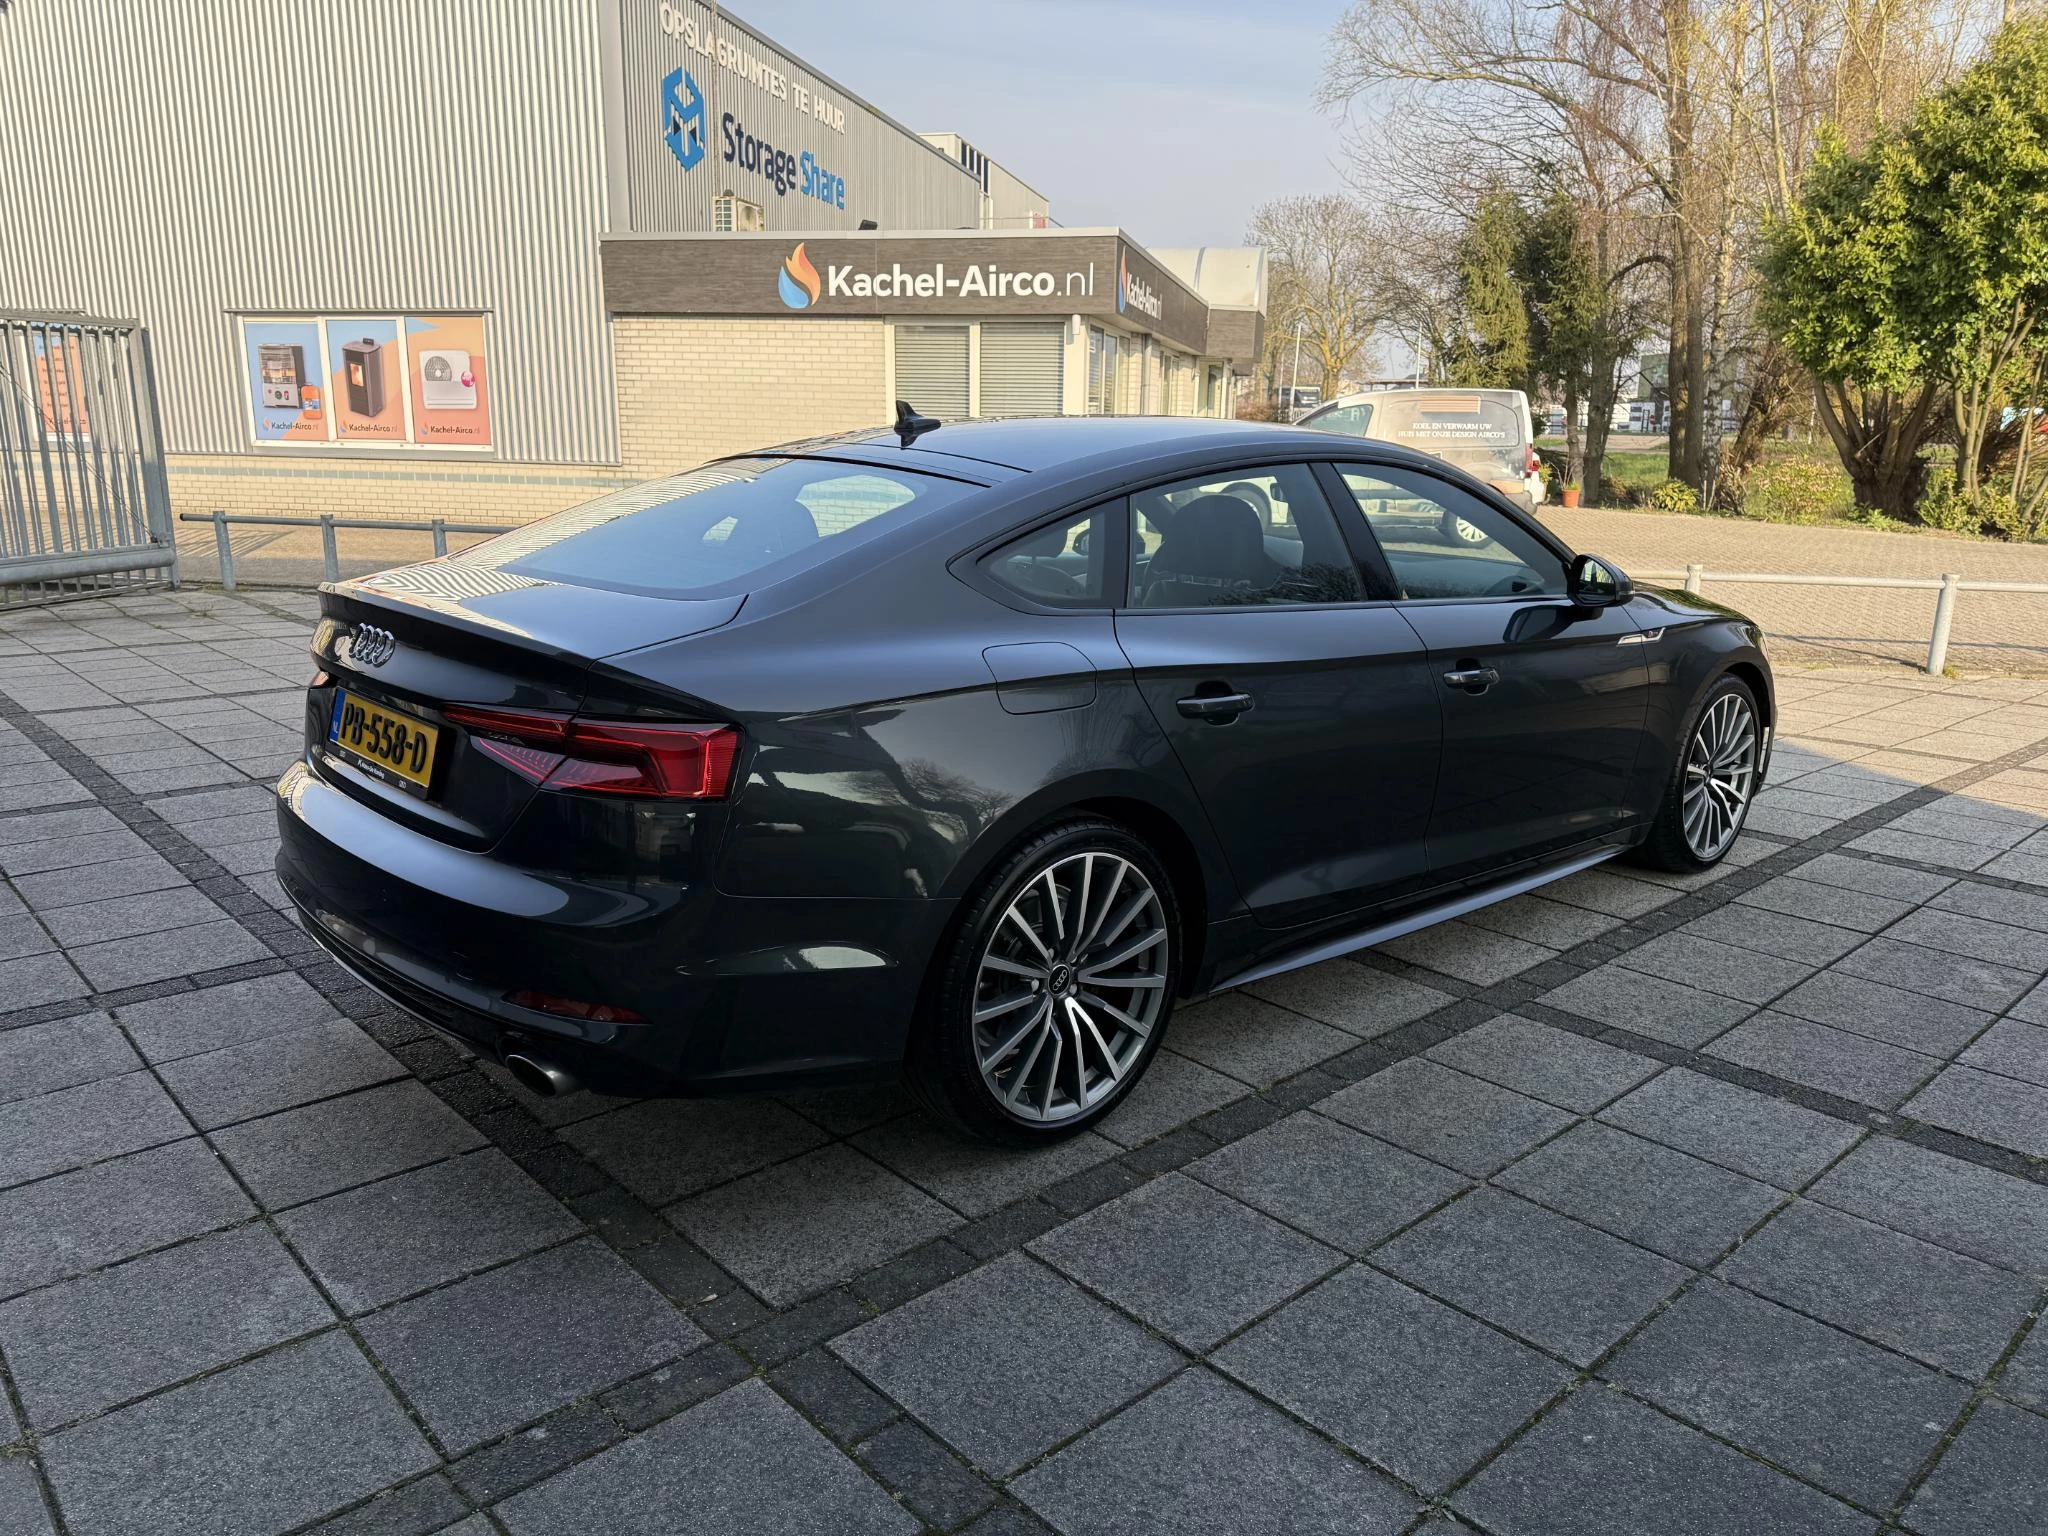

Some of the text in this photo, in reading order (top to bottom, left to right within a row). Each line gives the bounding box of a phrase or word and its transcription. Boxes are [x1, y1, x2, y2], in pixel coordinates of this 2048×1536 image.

[793, 82, 809, 115] TE
[814, 95, 845, 135] HUUR
[722, 112, 845, 210] Storage Share
[828, 262, 1094, 297] Kachel-Airco.nl
[1431, 422, 1441, 430] EN
[1442, 422, 1478, 431] VERWARM
[341, 702, 428, 774] PB-558-D
